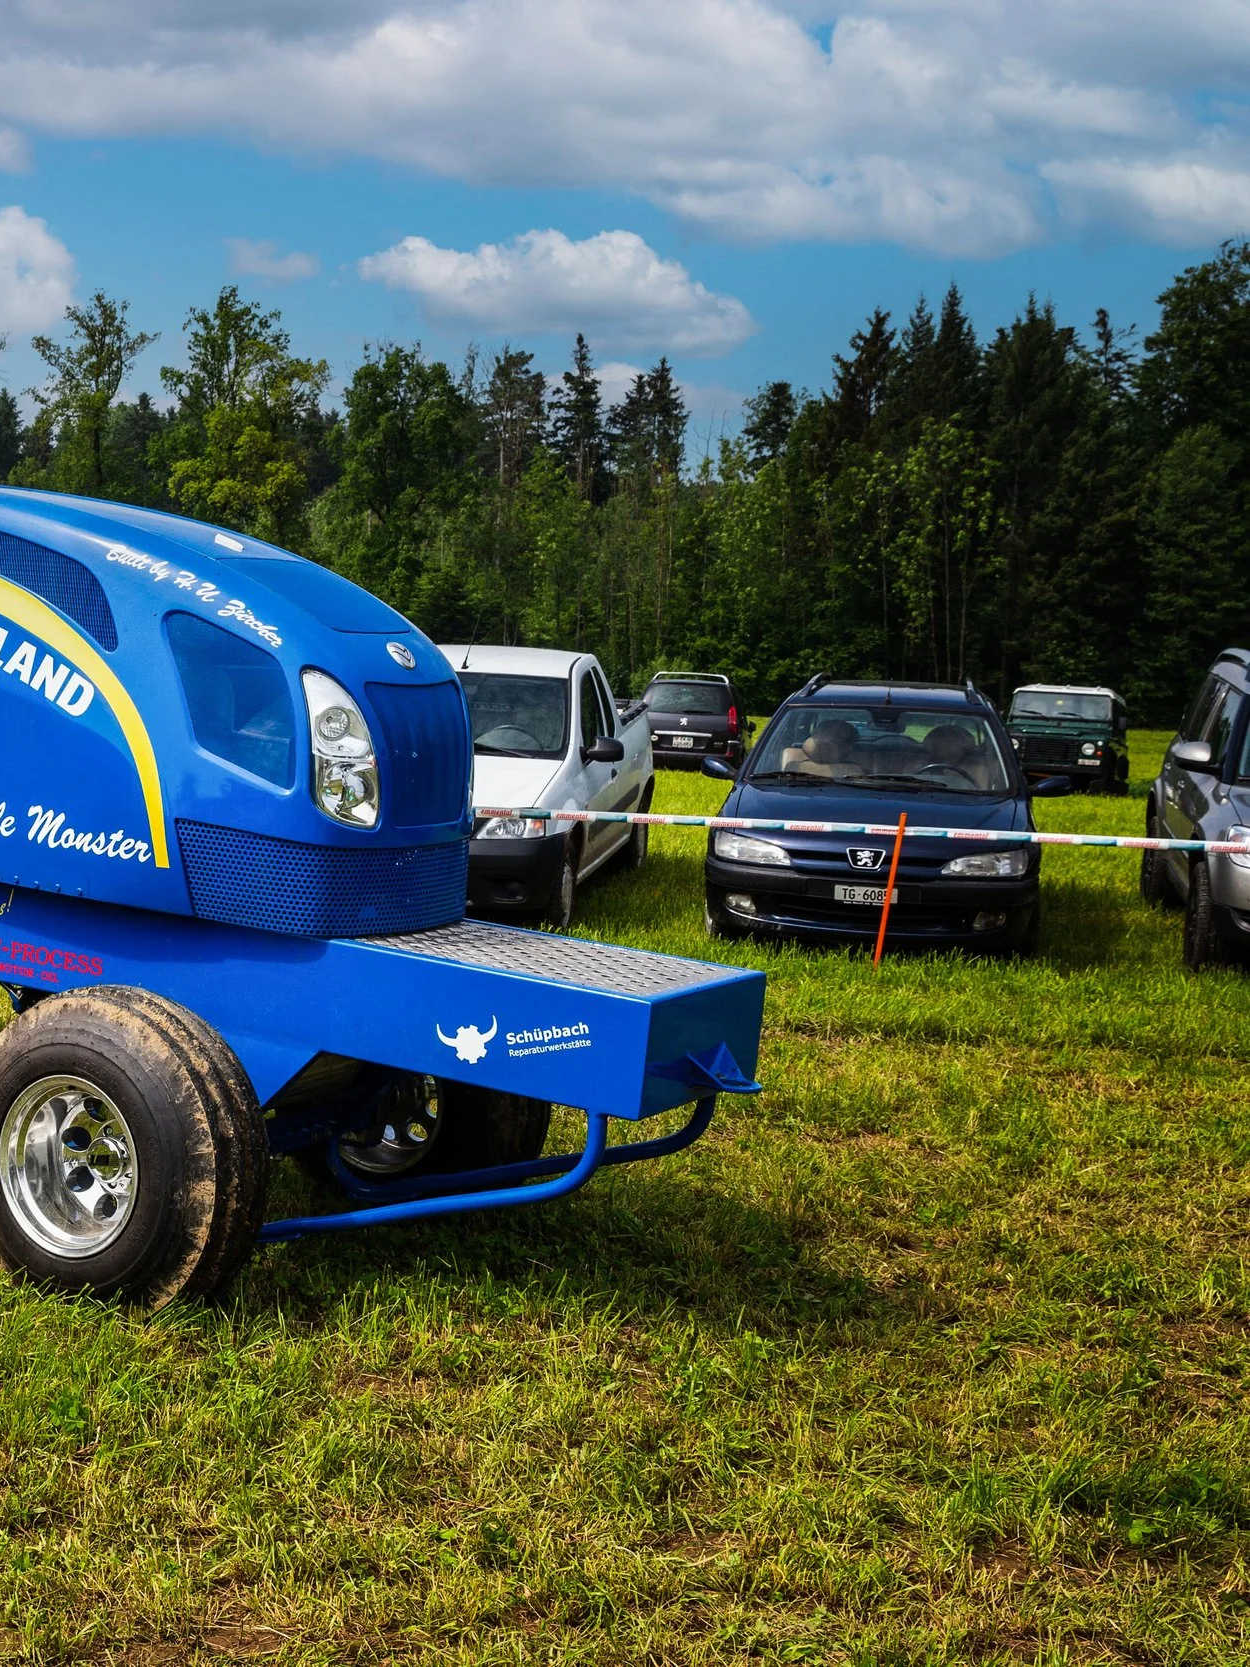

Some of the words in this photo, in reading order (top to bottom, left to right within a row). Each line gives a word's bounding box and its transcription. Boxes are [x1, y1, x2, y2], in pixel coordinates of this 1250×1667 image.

[149, 561, 170, 582] by
[218, 600, 282, 648] Zürcher
[480, 808, 513, 816] emmental
[556, 813, 589, 821] emmental
[632, 816, 666, 824] emmental
[710, 820, 744, 828] emmental
[789, 824, 824, 832] emmental
[27, 805, 151, 863] Monster
[953, 832, 989, 840] emmental
[1037, 836, 1073, 844] emmental
[1123, 841, 1160, 849] emmental
[1210, 844, 1248, 853] emmental
[506, 1022, 589, 1045] Schüpbach
[509, 1039, 592, 1057] Reparaturwerkstätte
